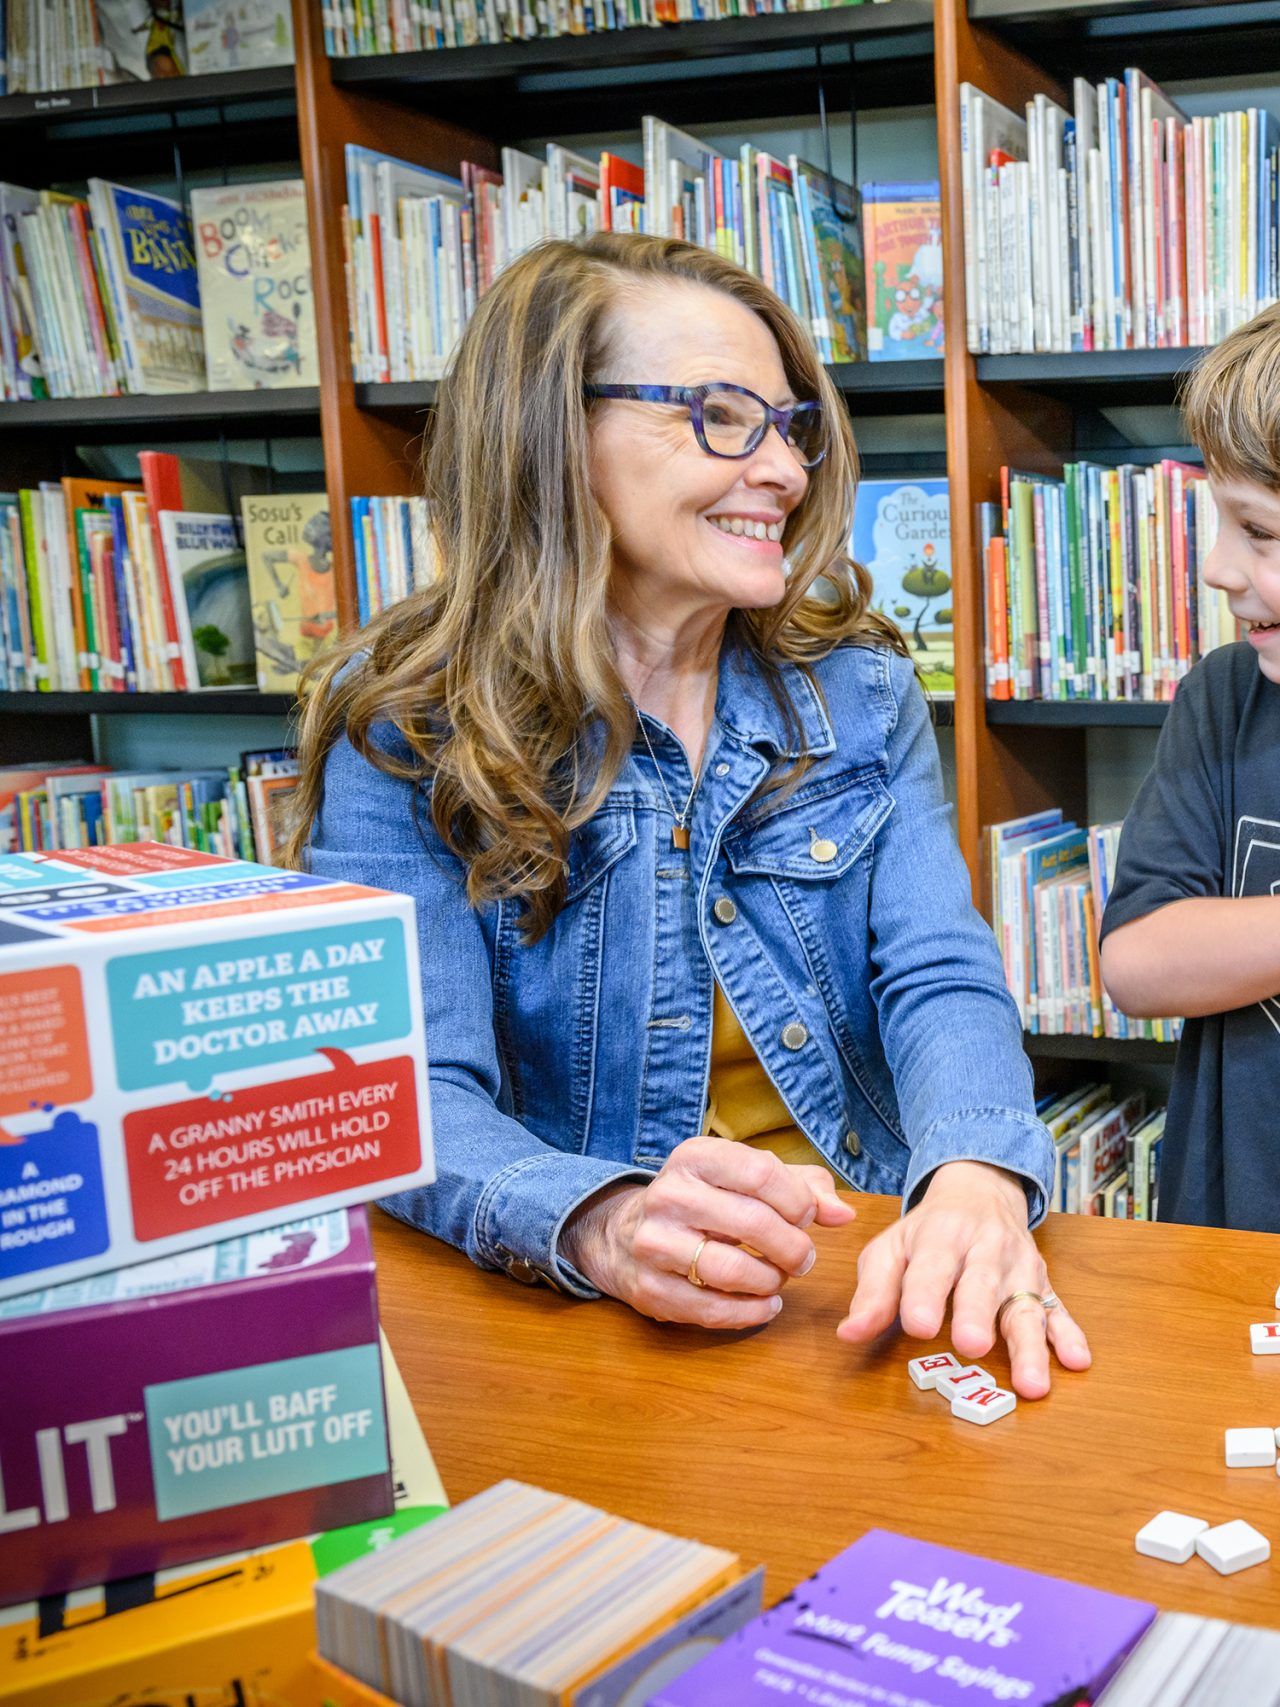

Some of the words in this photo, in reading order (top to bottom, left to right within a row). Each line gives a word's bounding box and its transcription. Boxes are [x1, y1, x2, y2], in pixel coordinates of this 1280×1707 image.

[263, 525, 299, 545] Call
[133, 968, 186, 1000] AN
[191, 953, 296, 992] APPLE
[299, 952, 324, 975] A
[325, 937, 386, 967] DAY
[181, 992, 271, 1027] KEEPS
[274, 974, 350, 1006] THE
[153, 1022, 289, 1067] DOCTOR
[293, 1001, 381, 1040] AWAY
[148, 1132, 168, 1156] A
[170, 1112, 265, 1151] GRANNY
[269, 1096, 336, 1128] SMITH
[338, 1081, 399, 1112] EVERY
[163, 1159, 192, 1182] 24
[196, 1141, 275, 1176] HOURS
[277, 1125, 328, 1158] WILL
[331, 1109, 391, 1143] HOLD
[178, 1179, 225, 1207] OFF
[228, 1168, 271, 1194] THE
[273, 1139, 382, 1186] PHYSICIAN
[27, 1197, 69, 1223] THE
[163, 1401, 257, 1444] YOU'LL
[268, 1383, 338, 1422] BAFF
[166, 1436, 245, 1477] YOUR
[250, 1420, 319, 1460] LUTT
[322, 1408, 375, 1444] OFF
